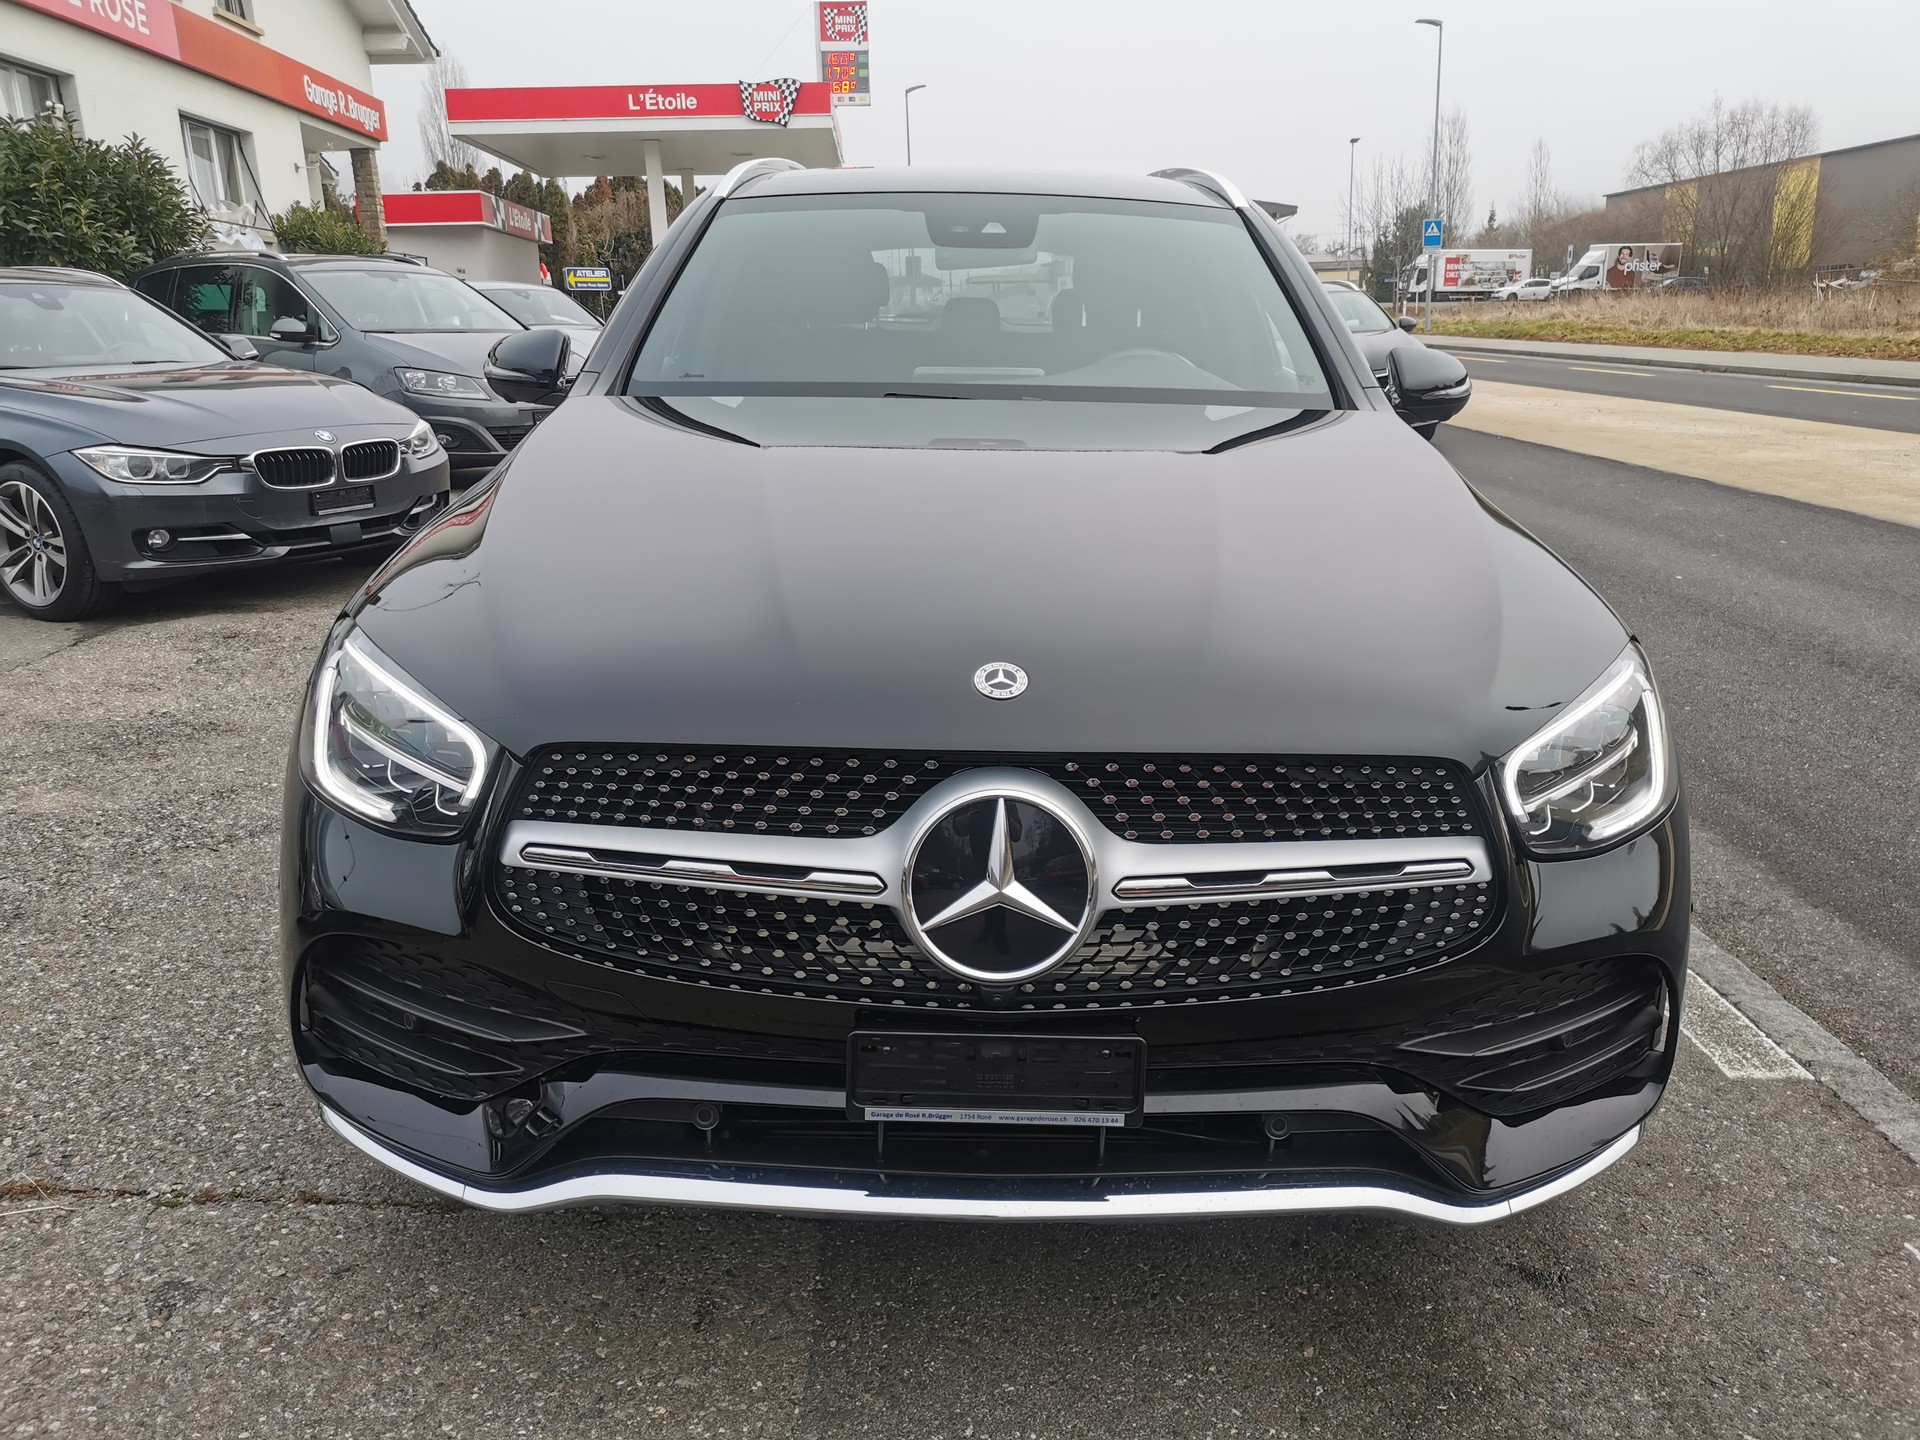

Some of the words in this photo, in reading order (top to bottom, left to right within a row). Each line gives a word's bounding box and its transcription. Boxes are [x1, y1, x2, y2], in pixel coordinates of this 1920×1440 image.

[835, 15, 856, 24] MINI
[835, 24, 857, 33] PRIX
[303, 74, 338, 116] Garage
[753, 90, 781, 102] MINI
[753, 101, 781, 113] PRIX
[1623, 258, 1663, 276] pfister
[576, 270, 607, 278] ATELIER
[870, 1111, 894, 1119] Garage
[998, 1114, 1068, 1123] www.garagederose.ch
